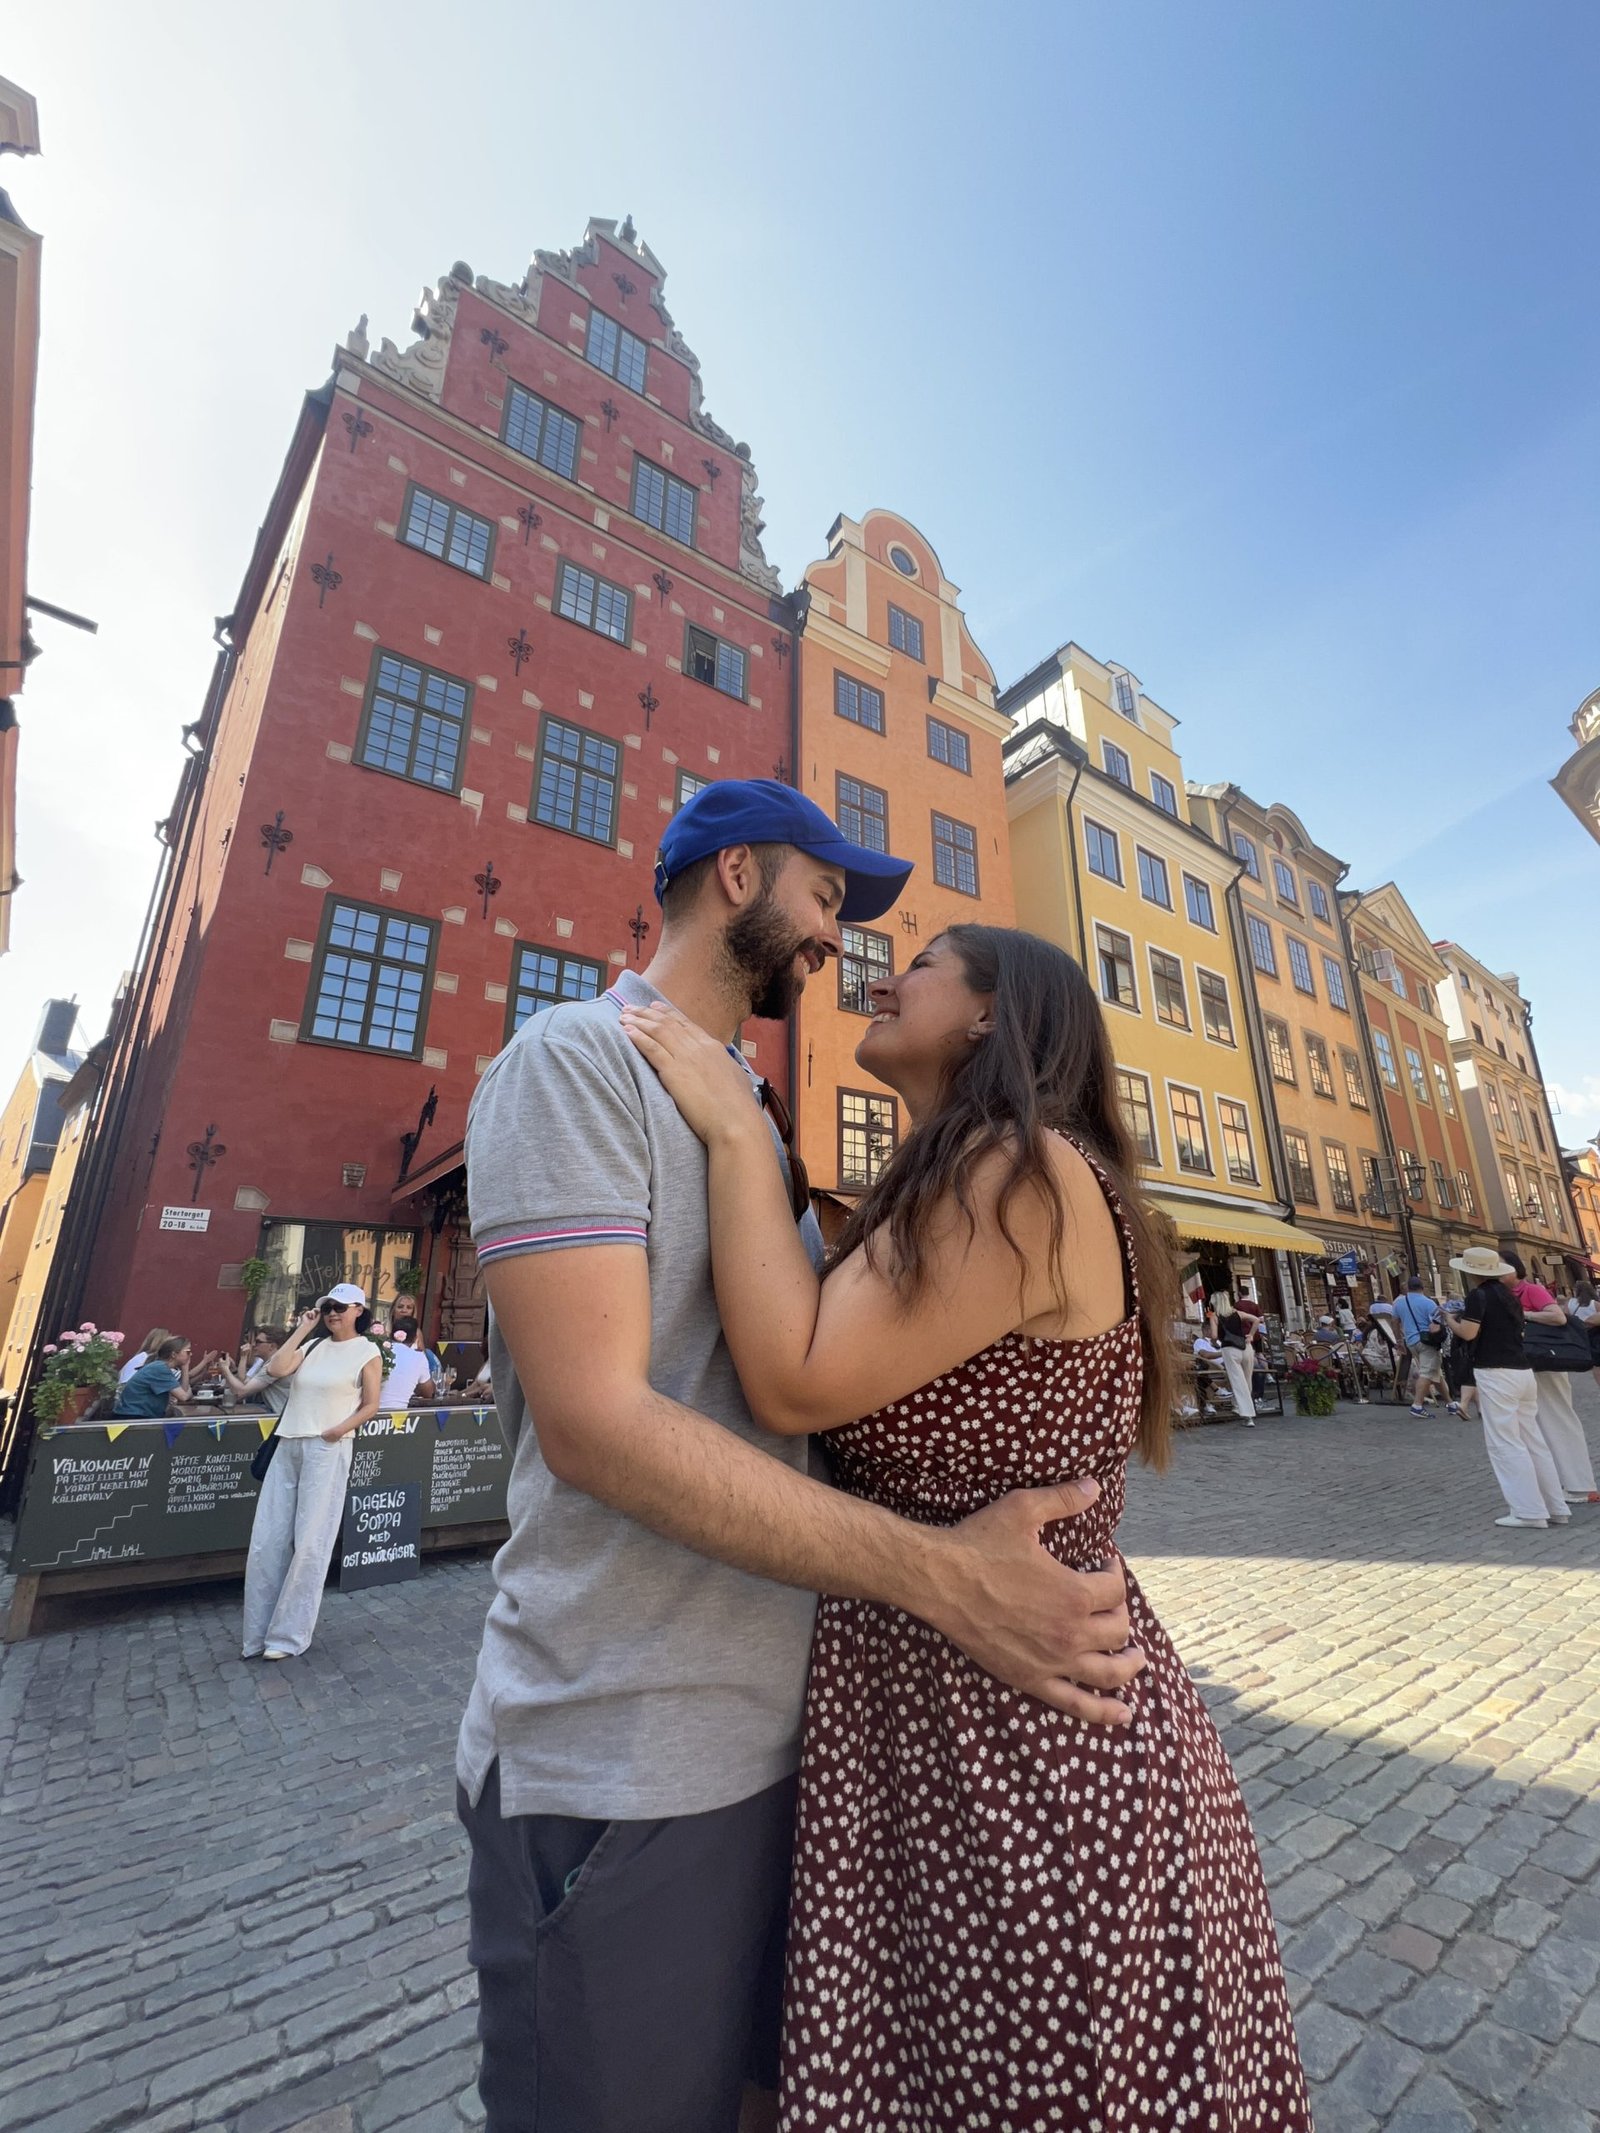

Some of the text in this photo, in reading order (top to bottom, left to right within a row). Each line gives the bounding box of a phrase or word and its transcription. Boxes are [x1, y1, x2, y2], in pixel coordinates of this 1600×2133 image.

[162, 1220, 186, 1229] 20-18
[53, 1453, 154, 1474] VÄLKOMMEN IN
[170, 1452, 256, 1467] JÄTTE KANELBULL
[56, 1469, 150, 1484] PÅ FIKA ELLER MAT
[170, 1465, 231, 1476] MOROTSKAKA
[168, 1472, 243, 1485] SOMRIG HALLON
[64, 1482, 97, 1493] VÅRAT
[52, 1492, 114, 1504] KÄLLARVALV
[351, 1490, 406, 1516] DAGENS
[356, 1512, 402, 1533] SOPPA
[368, 1530, 391, 1543] MED
[343, 1543, 417, 1567] OST SMÖRGÅSAR
